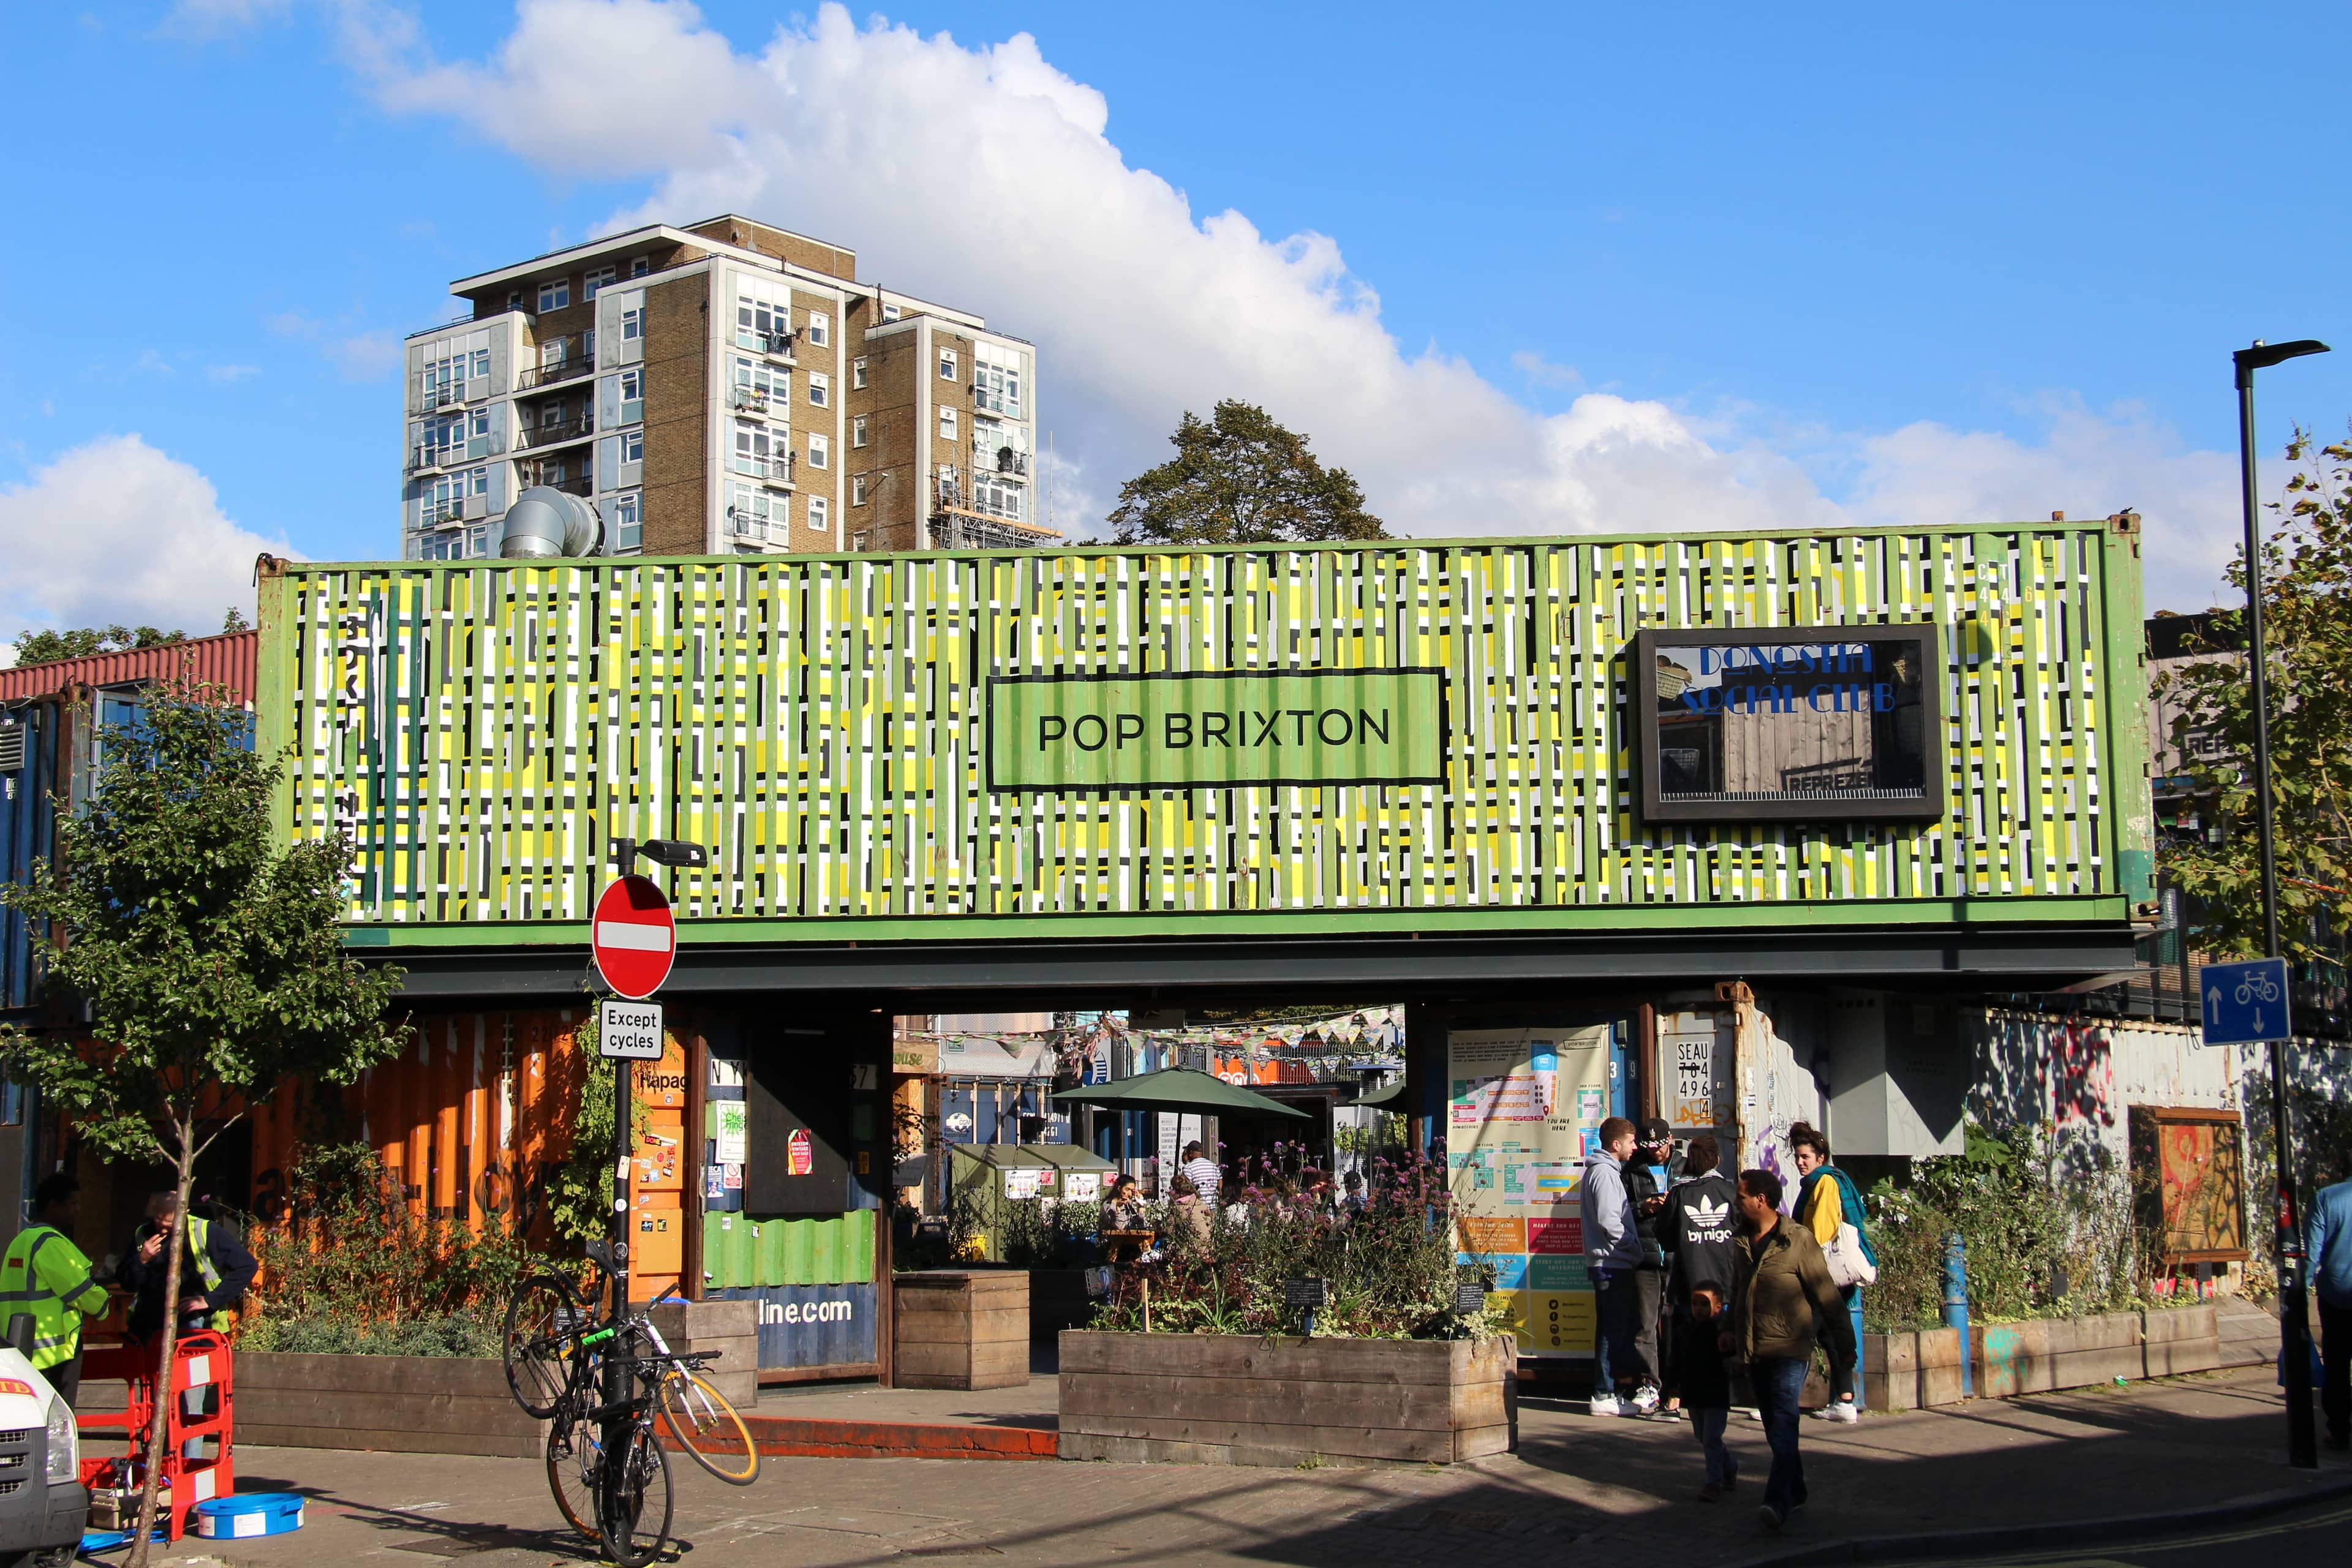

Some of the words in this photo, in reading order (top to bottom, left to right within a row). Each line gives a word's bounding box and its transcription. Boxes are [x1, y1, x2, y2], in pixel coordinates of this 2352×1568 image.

[1700, 643, 1872, 676] DONOSTIA
[1682, 685, 1798, 715] SOCIAL
[1808, 684, 1896, 714] CLUB
[1039, 713, 1144, 752] POP
[1165, 708, 1389, 749] BRIXTON
[608, 1009, 657, 1030] Except
[609, 1033, 654, 1049] cycles
[1678, 1043, 1708, 1060] SEAU
[1680, 1080, 1709, 1097] 496
[1702, 1100, 1709, 1117] 4
[1687, 1230, 1702, 1244] by
